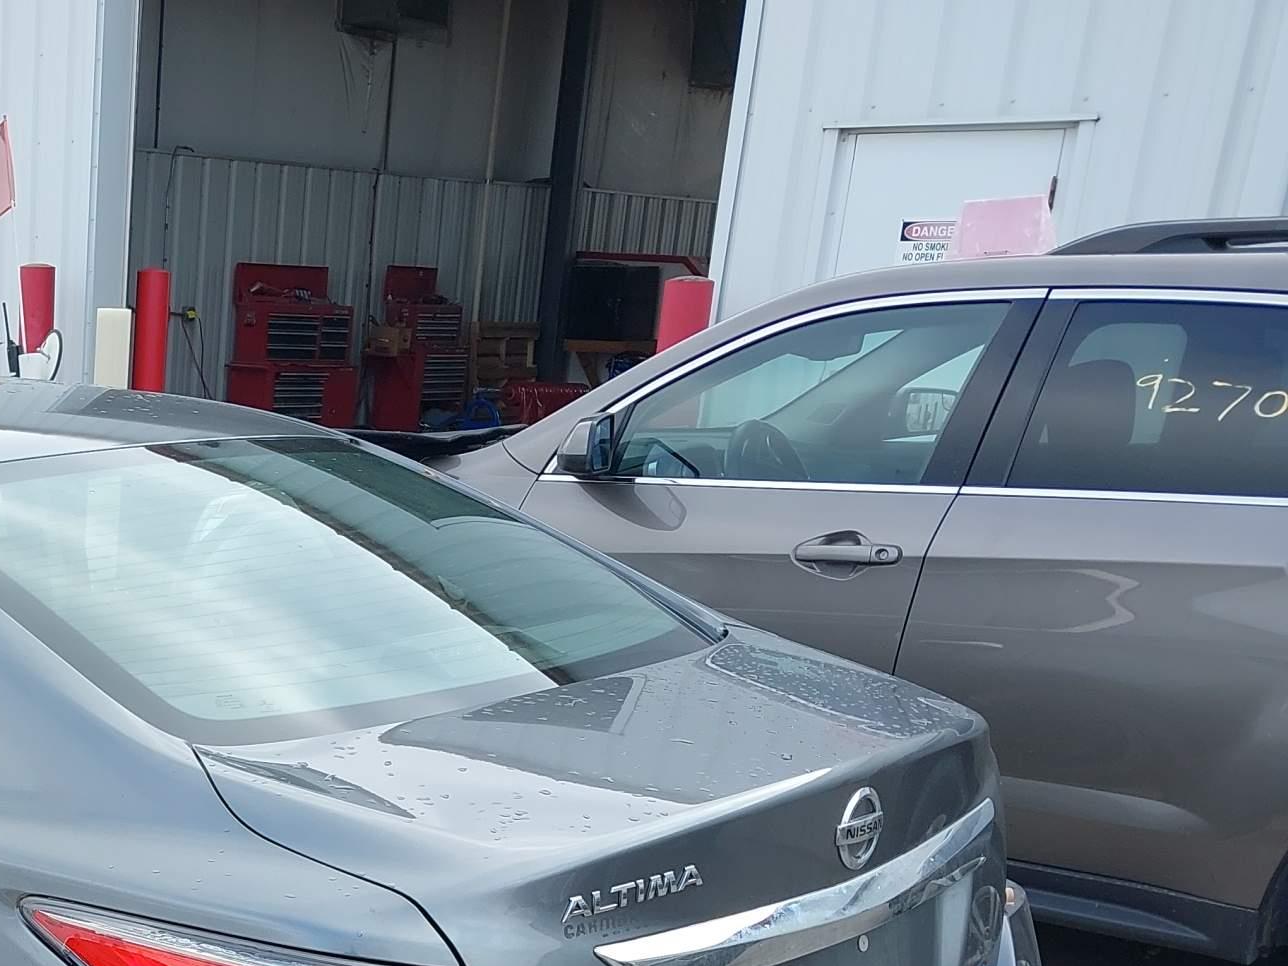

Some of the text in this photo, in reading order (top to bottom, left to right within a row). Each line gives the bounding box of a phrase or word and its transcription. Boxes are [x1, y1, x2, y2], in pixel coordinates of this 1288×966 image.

[912, 226, 955, 236] DANGE
[925, 242, 948, 250] SMOKI
[915, 252, 934, 260] OPEN
[846, 819, 881, 840] NISSAN
[561, 865, 703, 923] ALTIMA
